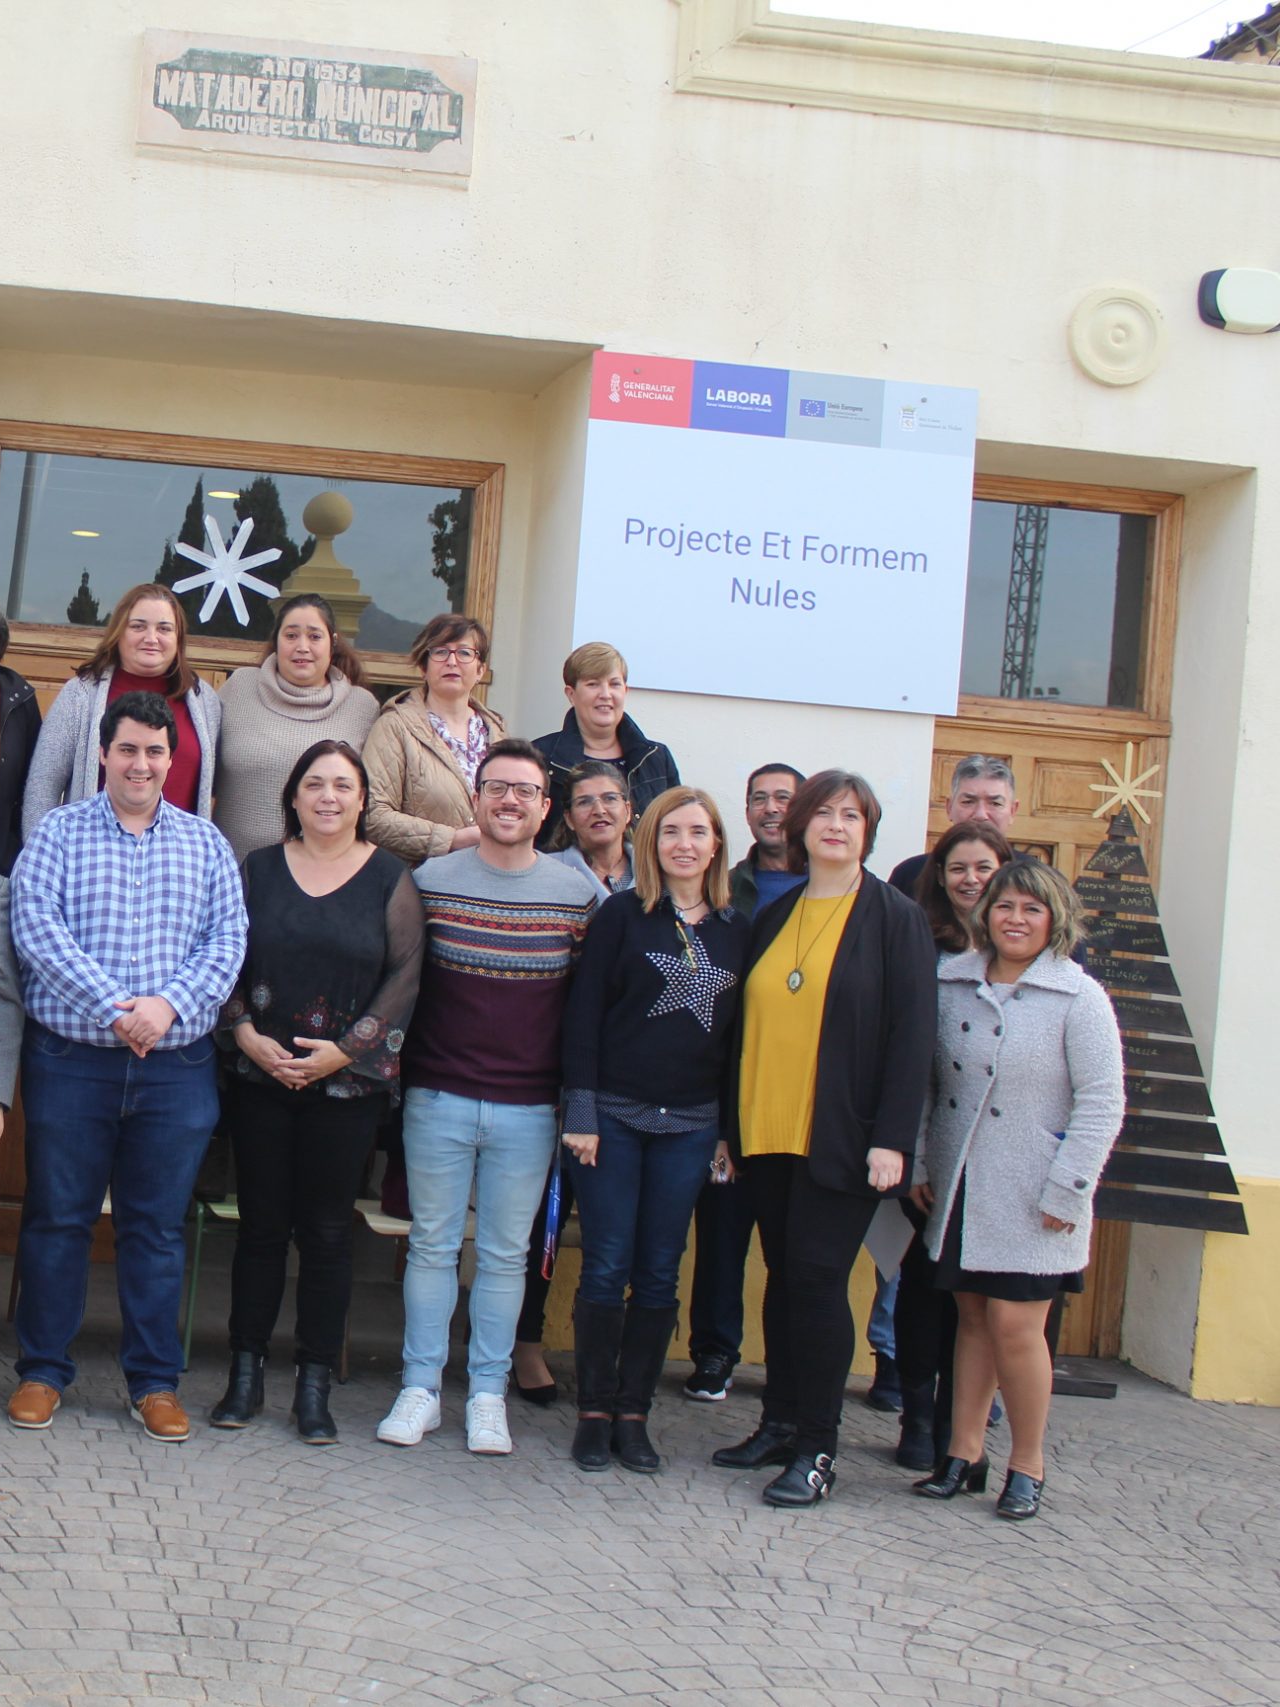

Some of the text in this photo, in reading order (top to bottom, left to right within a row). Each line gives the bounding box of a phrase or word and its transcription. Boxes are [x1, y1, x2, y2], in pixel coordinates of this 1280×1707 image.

[158, 69, 458, 133] MATADERO MUNICIPAL
[195, 109, 320, 139] ARQUITECTO
[358, 125, 417, 148] COSTA
[623, 381, 676, 394] GENERALITAT
[623, 389, 674, 402] VALENCIANA
[706, 388, 772, 407] LABORA
[624, 517, 928, 573] Projecte Et Formem
[730, 576, 817, 611] Nules
